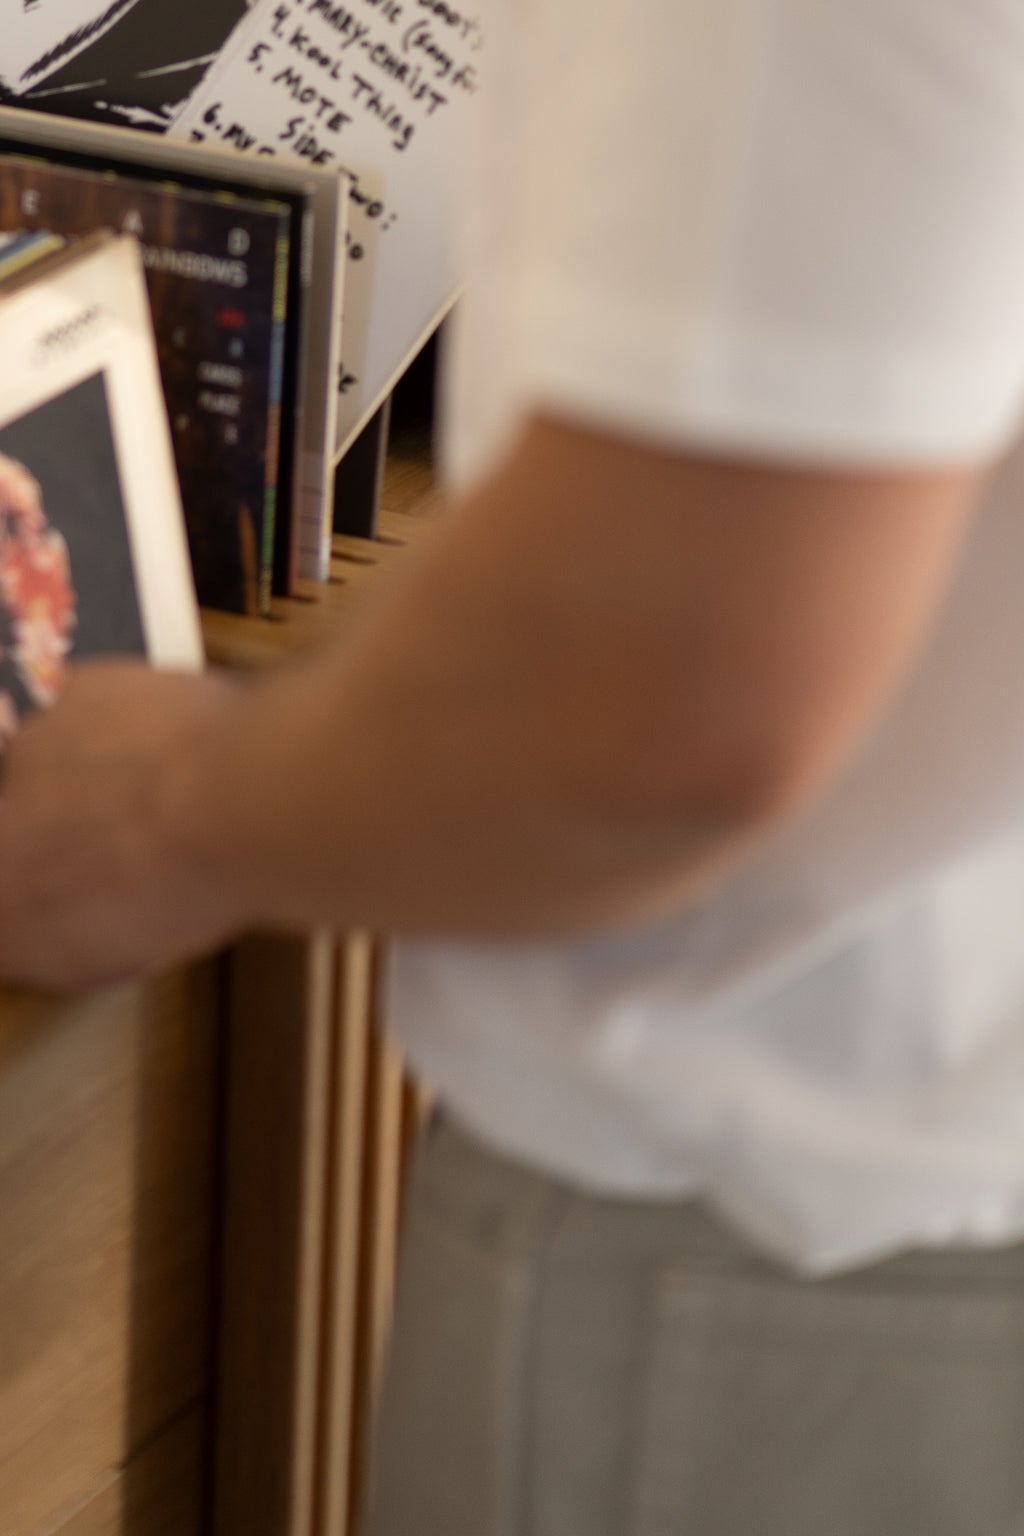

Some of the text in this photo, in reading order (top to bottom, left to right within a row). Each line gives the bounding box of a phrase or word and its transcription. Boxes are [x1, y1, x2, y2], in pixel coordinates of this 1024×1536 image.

[270, 4, 291, 39] 4.
[246, 41, 354, 135] 5. MOTE
[203, 102, 222, 131] 6.
